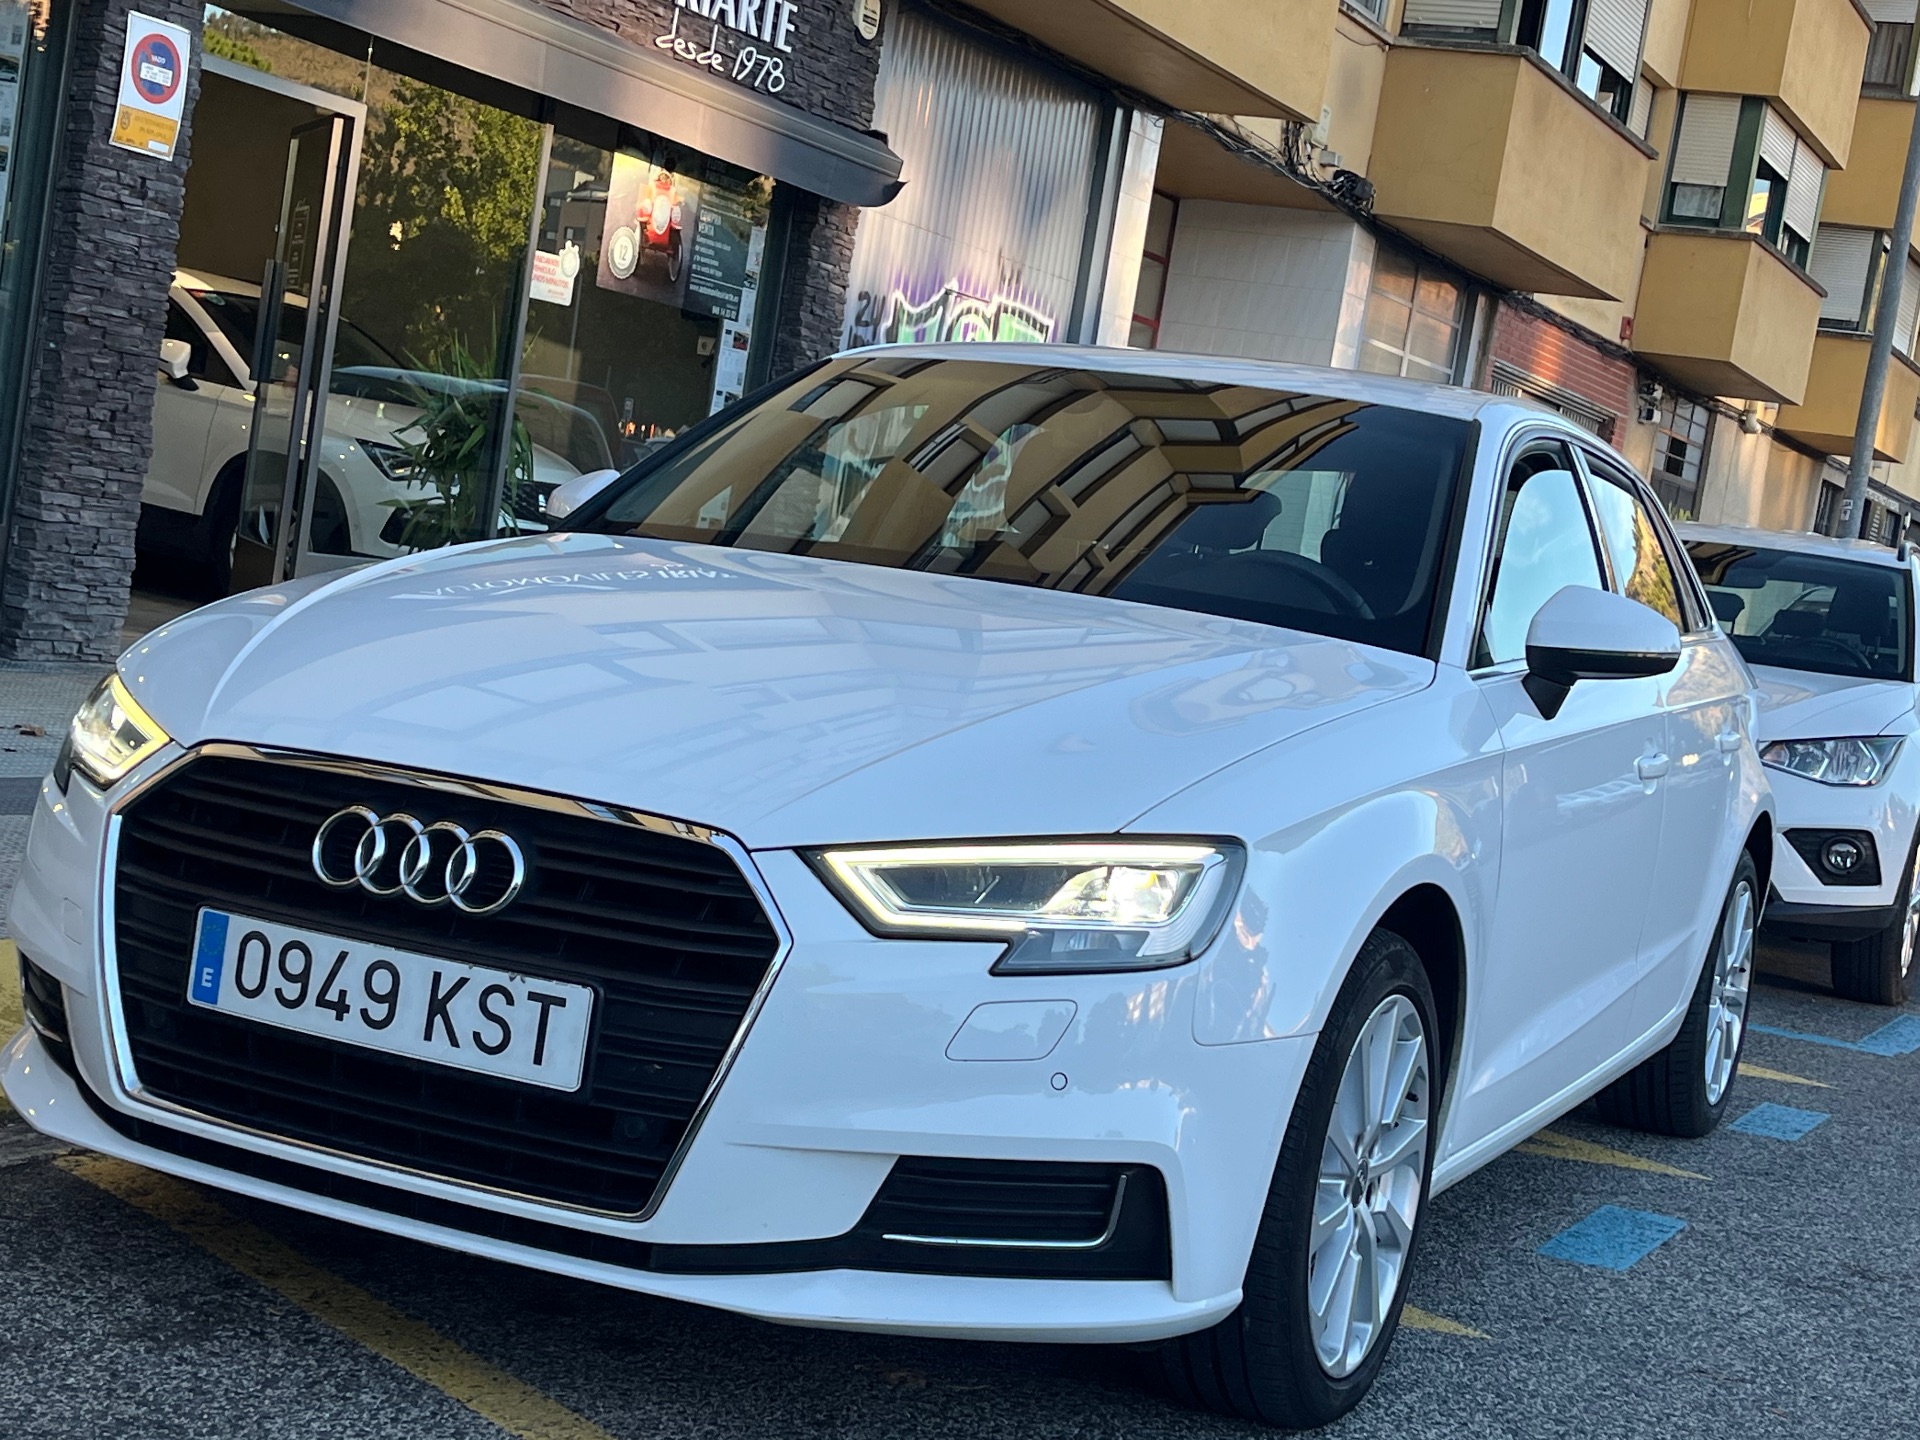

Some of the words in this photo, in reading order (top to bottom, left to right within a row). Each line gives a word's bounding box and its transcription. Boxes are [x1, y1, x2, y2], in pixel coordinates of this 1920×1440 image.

[674, 0, 798, 53] ARTE
[151, 54, 166, 65] VADO
[655, 7, 725, 72] desde
[732, 46, 785, 93] 1978
[619, 243, 628, 261] 12
[200, 967, 214, 988] E
[233, 929, 402, 1031] 0949
[423, 970, 567, 1066] KST
